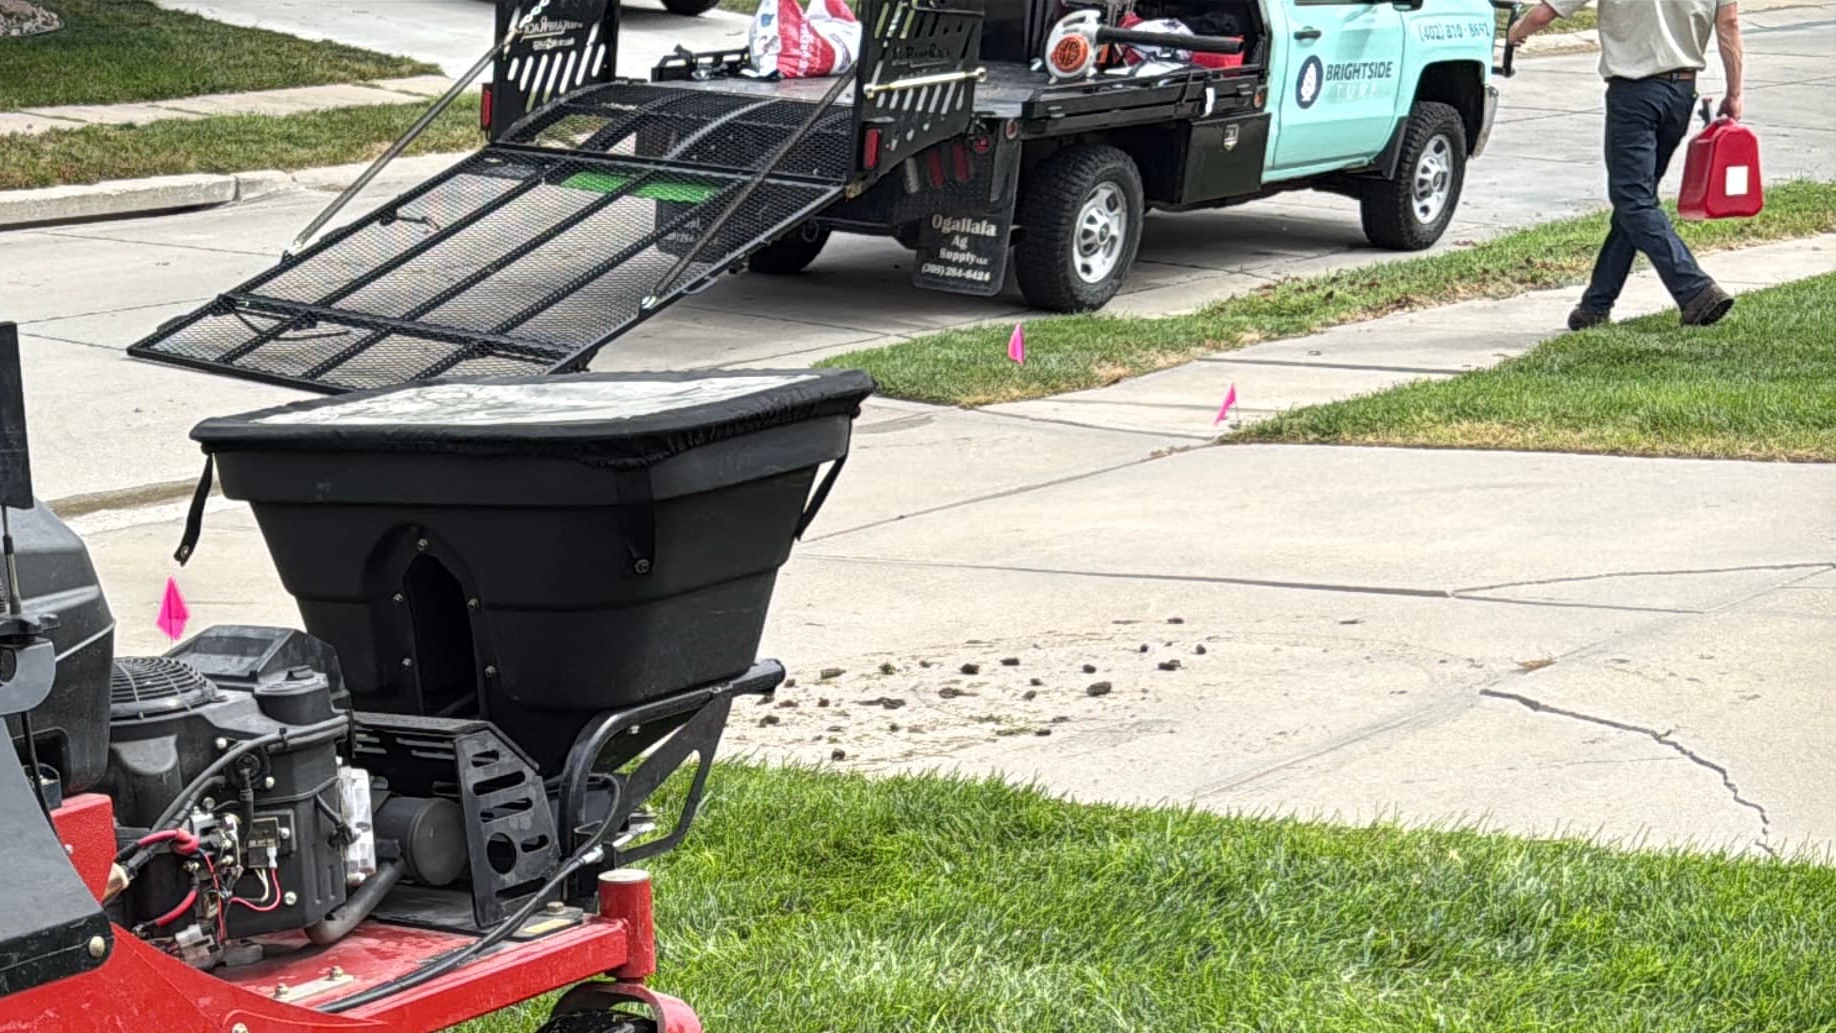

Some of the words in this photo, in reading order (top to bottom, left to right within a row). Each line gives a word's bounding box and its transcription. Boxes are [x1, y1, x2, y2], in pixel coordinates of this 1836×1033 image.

[1325, 61, 1393, 81] BRIGHTSIDE
[931, 214, 997, 237] Ogallala
[951, 234, 969, 250] Ag
[939, 247, 977, 265] Supply
